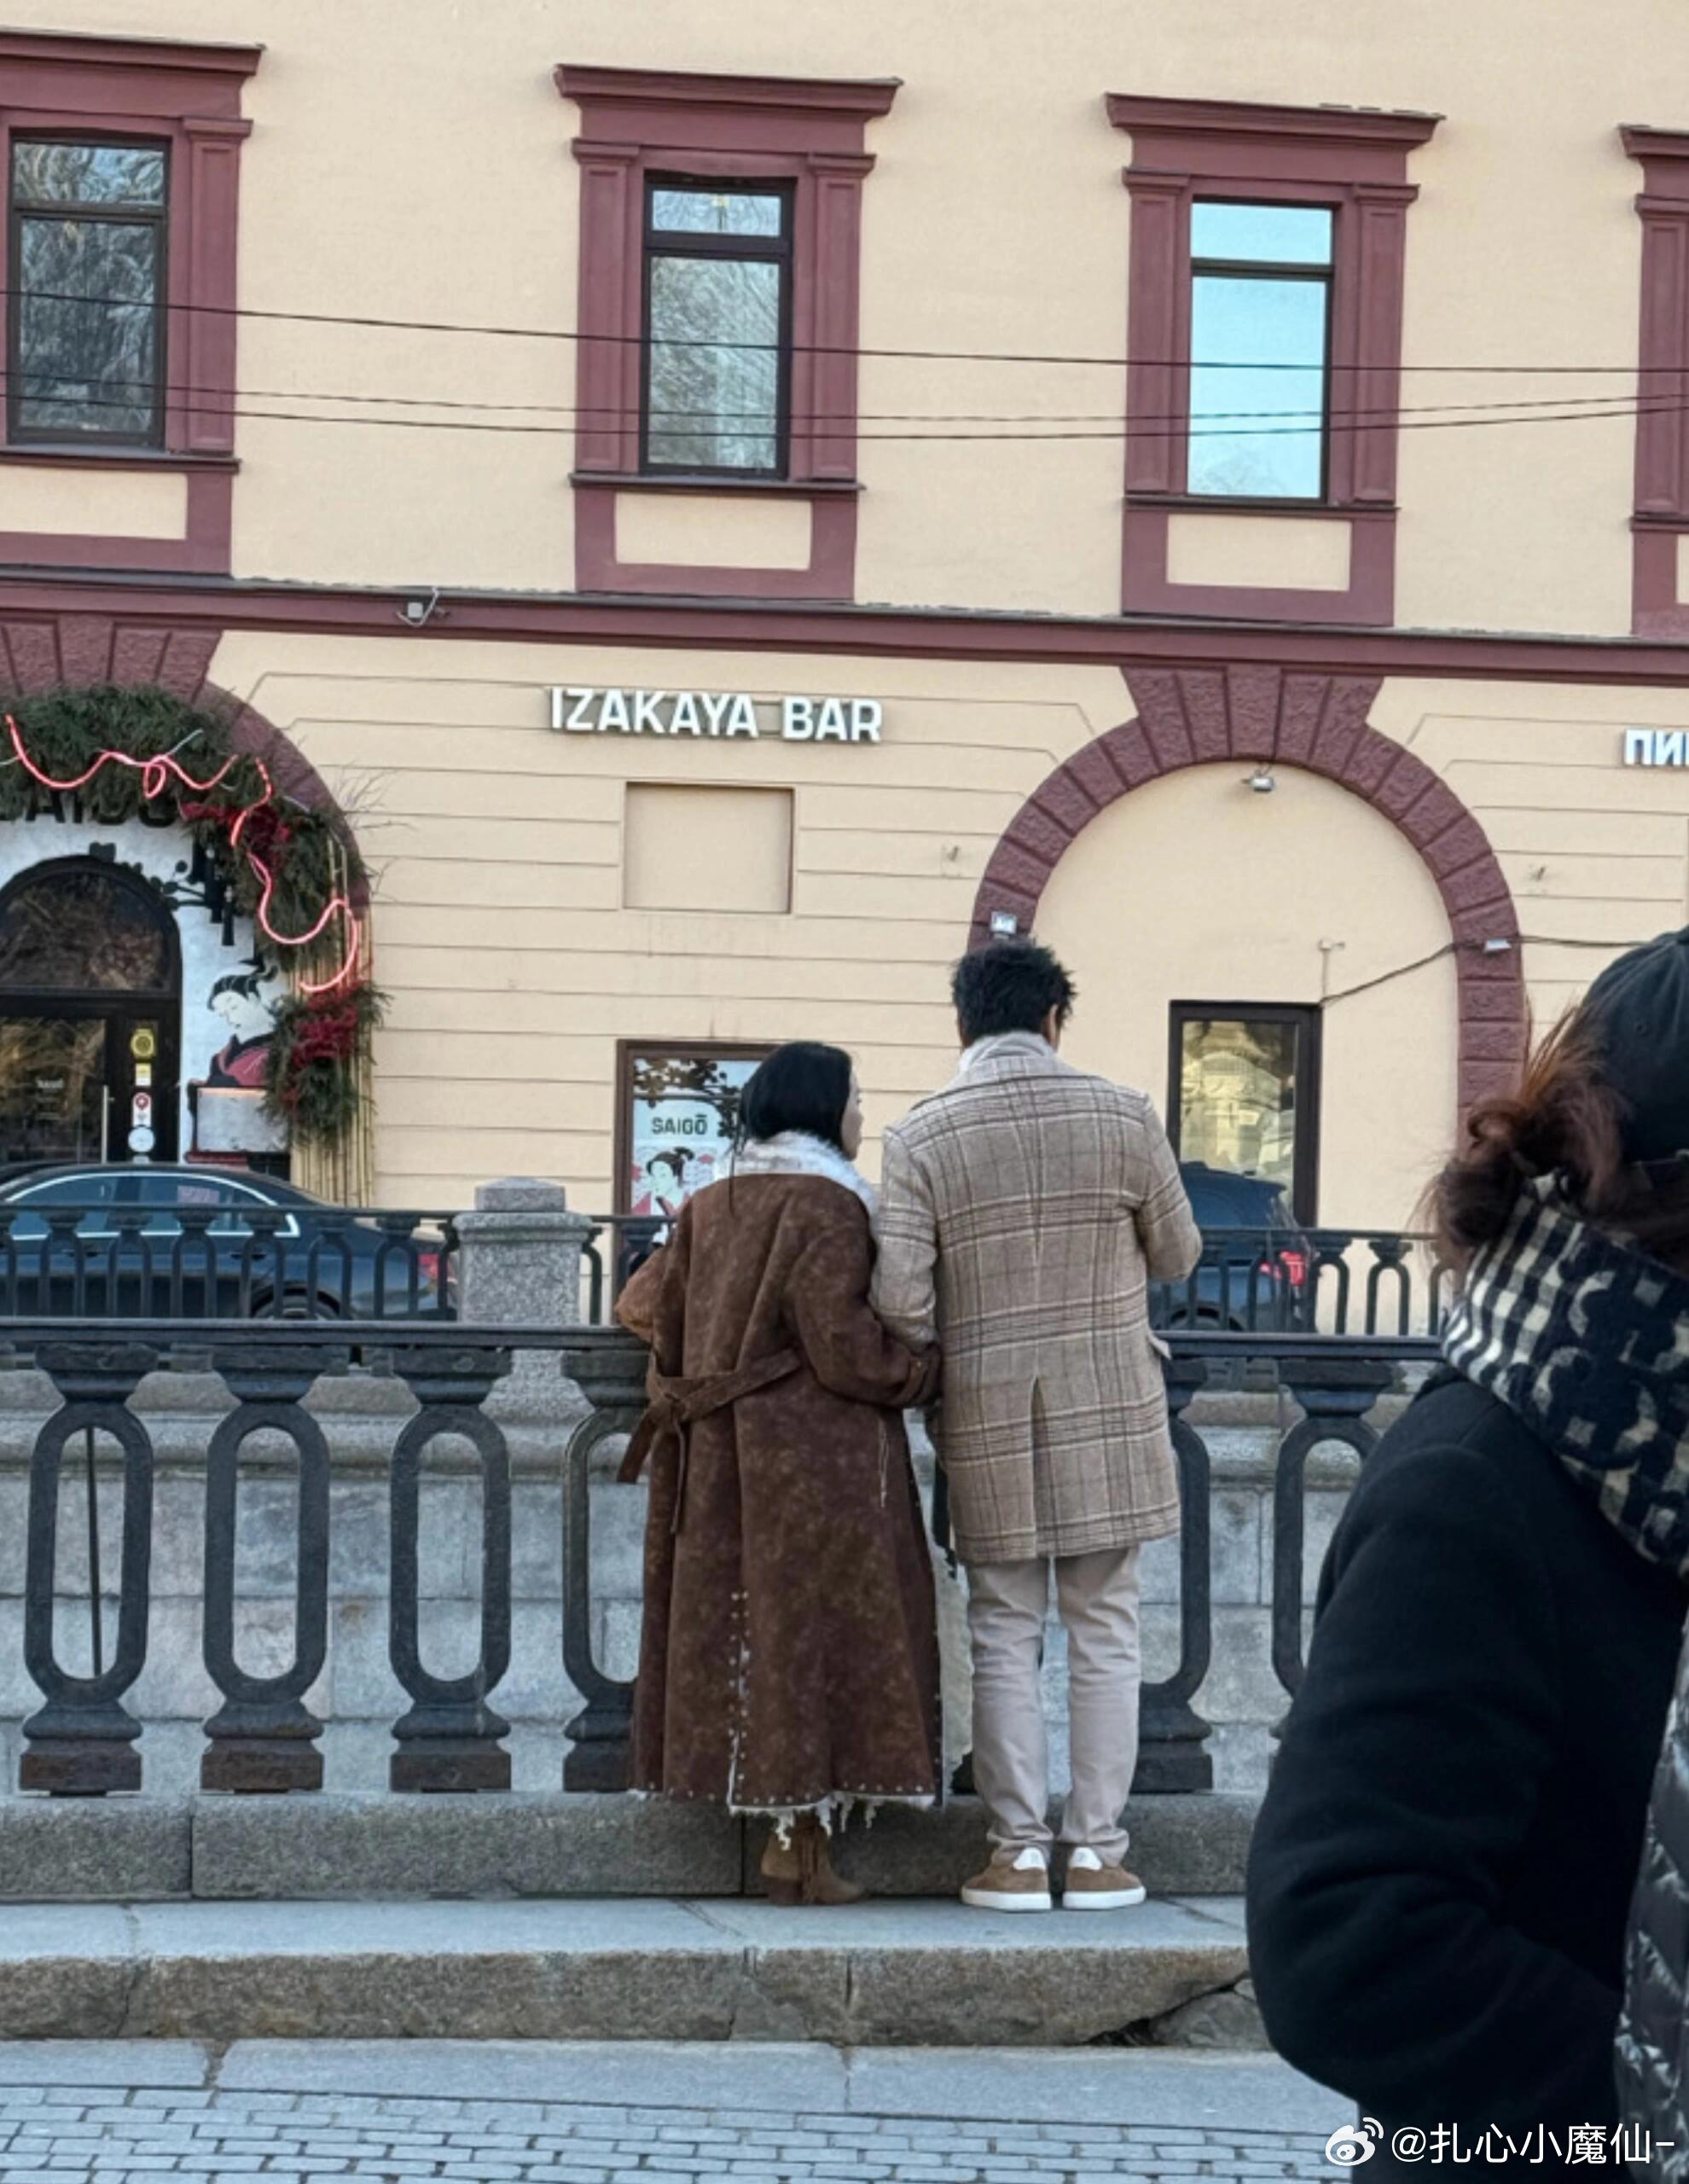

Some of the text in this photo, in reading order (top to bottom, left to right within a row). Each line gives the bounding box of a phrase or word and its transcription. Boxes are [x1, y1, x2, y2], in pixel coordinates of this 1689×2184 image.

[550, 687, 883, 742] IZAKAYA BAR
[1624, 729, 1689, 766] ПИ
